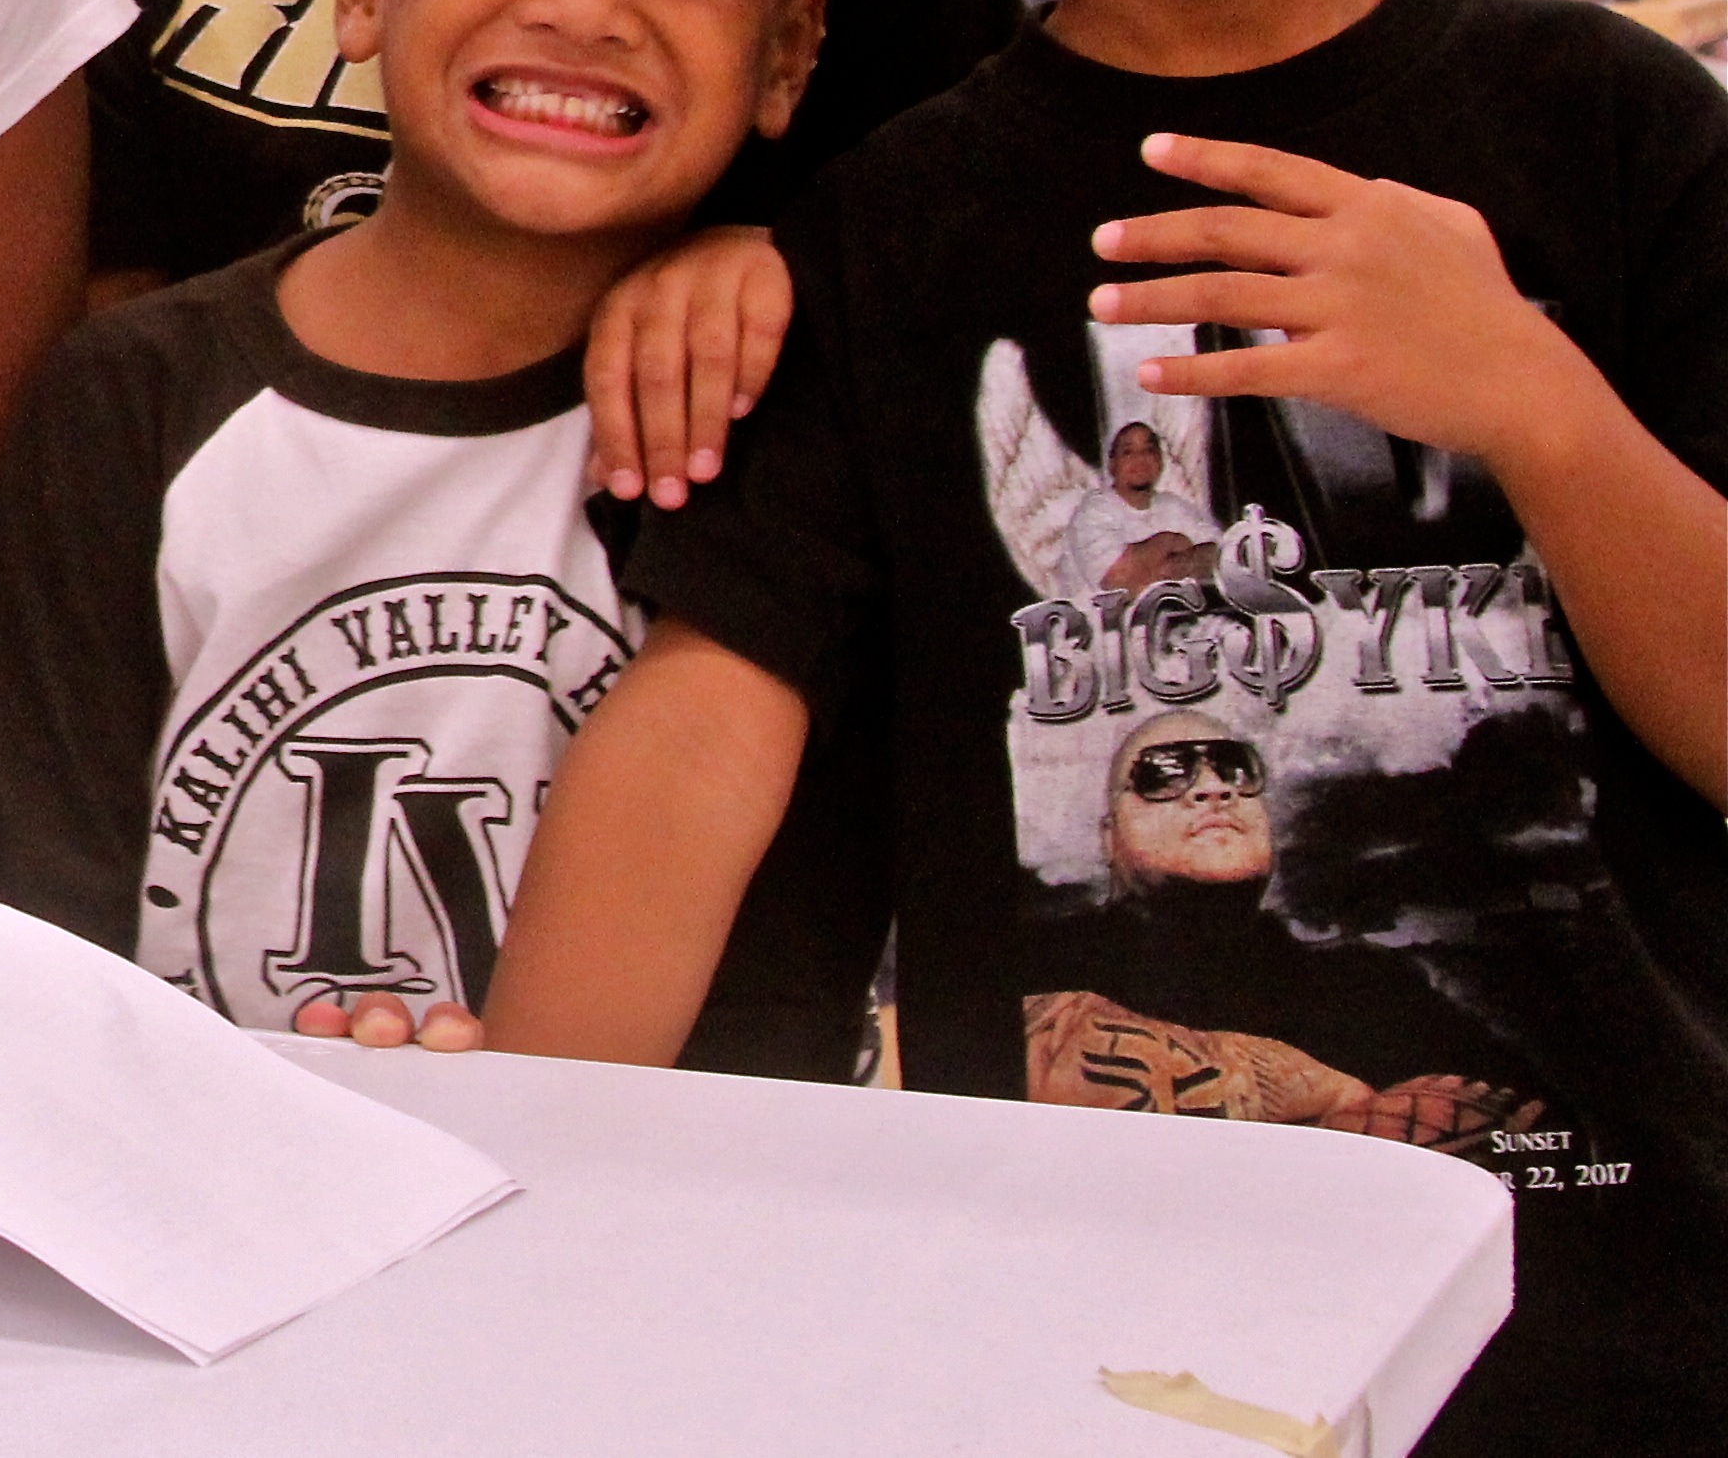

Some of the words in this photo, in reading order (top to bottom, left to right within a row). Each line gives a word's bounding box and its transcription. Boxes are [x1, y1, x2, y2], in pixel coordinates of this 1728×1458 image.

[153, 646, 319, 856] KALIHI
[331, 592, 570, 670] VALLEY
[1525, 1165, 1565, 1192] 22,
[1574, 1162, 1633, 1187] 2017
